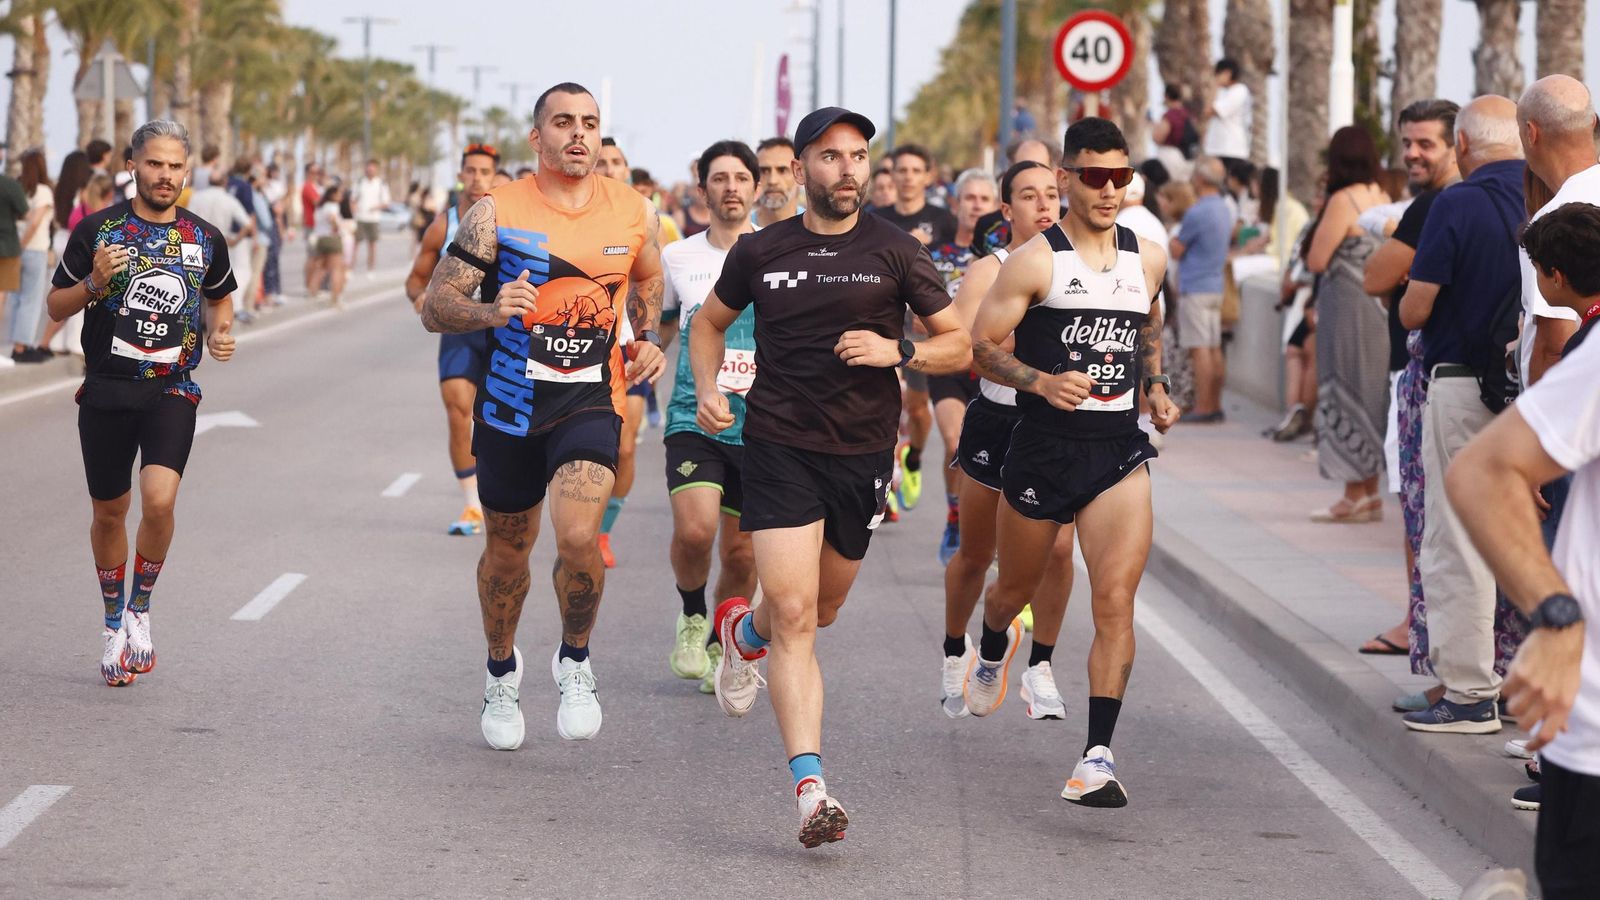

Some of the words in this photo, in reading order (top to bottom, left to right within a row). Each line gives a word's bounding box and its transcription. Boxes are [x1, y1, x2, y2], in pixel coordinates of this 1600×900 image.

[1071, 35, 1111, 65] 40
[183, 254, 200, 264] AXA
[816, 274, 849, 283] Tierra
[851, 273, 881, 284] Meta
[136, 282, 180, 305] PONLE
[131, 292, 172, 314] FRENO
[135, 319, 168, 337] 198
[1061, 316, 1137, 347] delikia
[544, 336, 594, 354] 1057
[1087, 364, 1125, 380] 892
